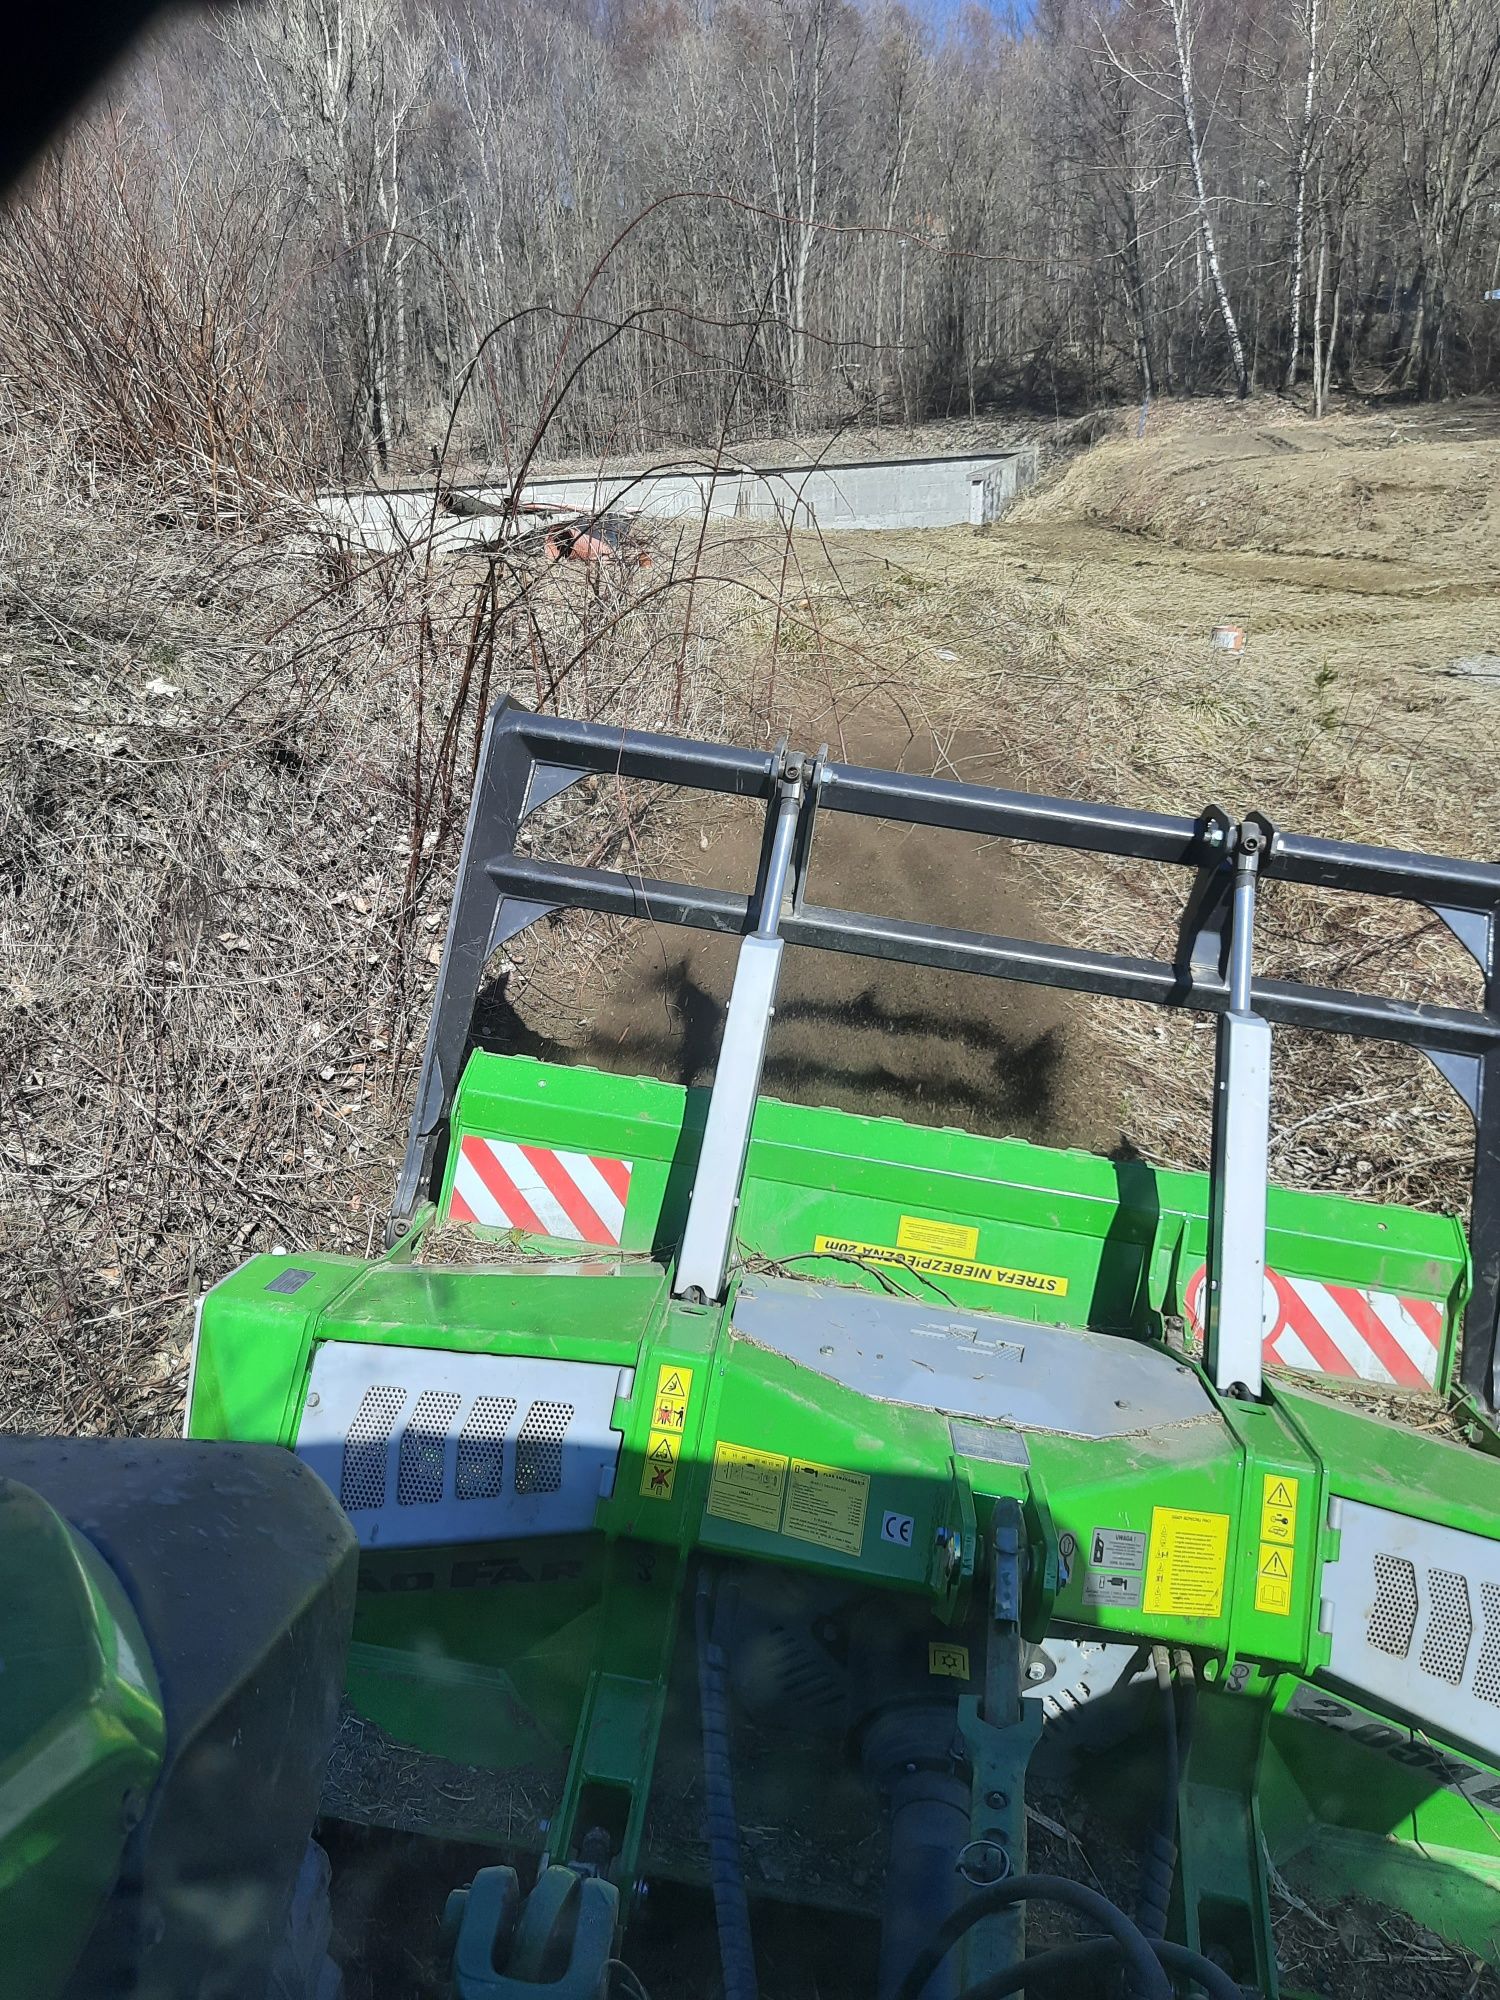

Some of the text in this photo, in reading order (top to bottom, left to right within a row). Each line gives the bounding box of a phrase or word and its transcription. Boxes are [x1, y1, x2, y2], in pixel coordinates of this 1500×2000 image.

[862, 1246, 992, 1280] NIEBEZPIECZNA
[996, 1269, 1057, 1292] STREFA
[886, 1516, 911, 1542] CE
[358, 1568, 435, 1592] AO
